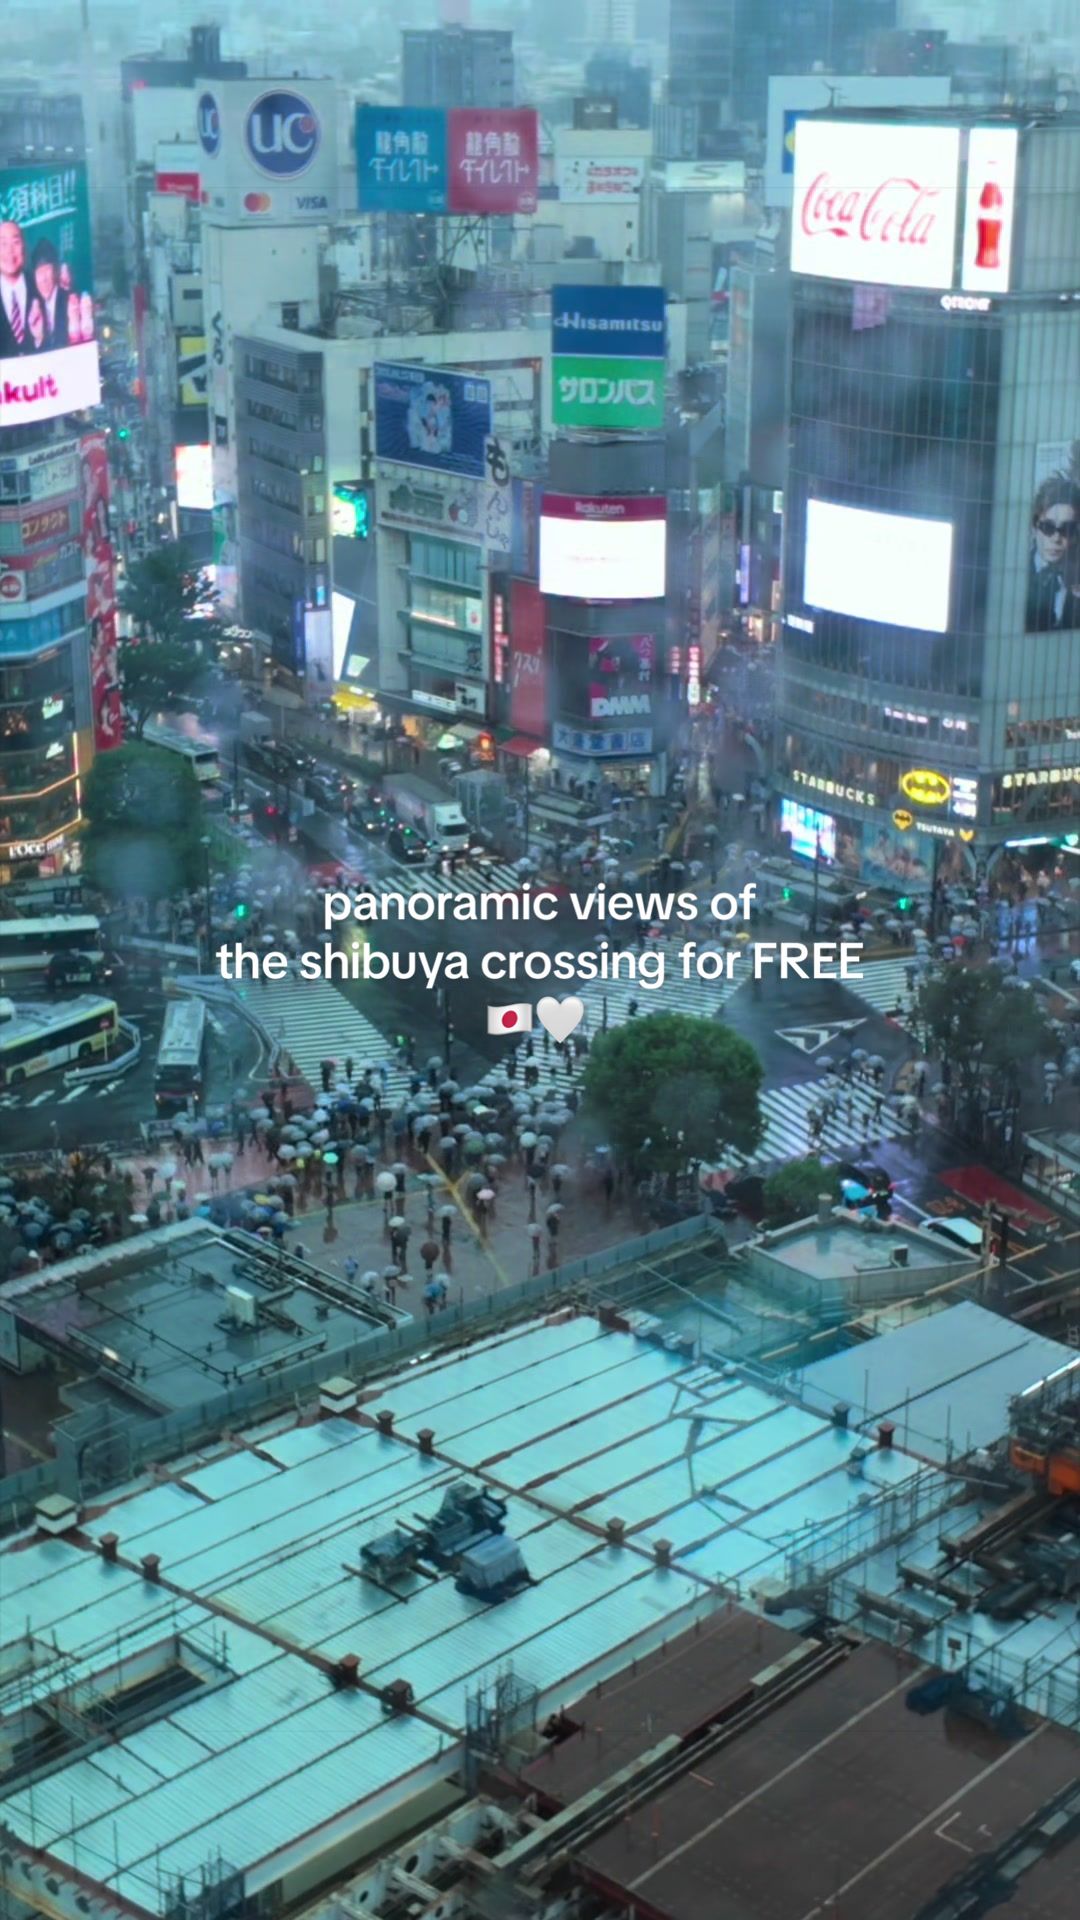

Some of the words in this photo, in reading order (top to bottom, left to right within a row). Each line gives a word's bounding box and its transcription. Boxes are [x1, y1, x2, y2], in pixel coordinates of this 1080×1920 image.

[0, 168, 77, 221] 須科目!!
[295, 196, 328, 210] VISA
[554, 311, 663, 332] Hisamitsu
[0, 374, 59, 405] kult
[557, 375, 656, 406] サロンパス
[574, 501, 626, 515] Rakuten
[591, 694, 651, 718] DMM
[792, 769, 876, 807] STARBUCKS
